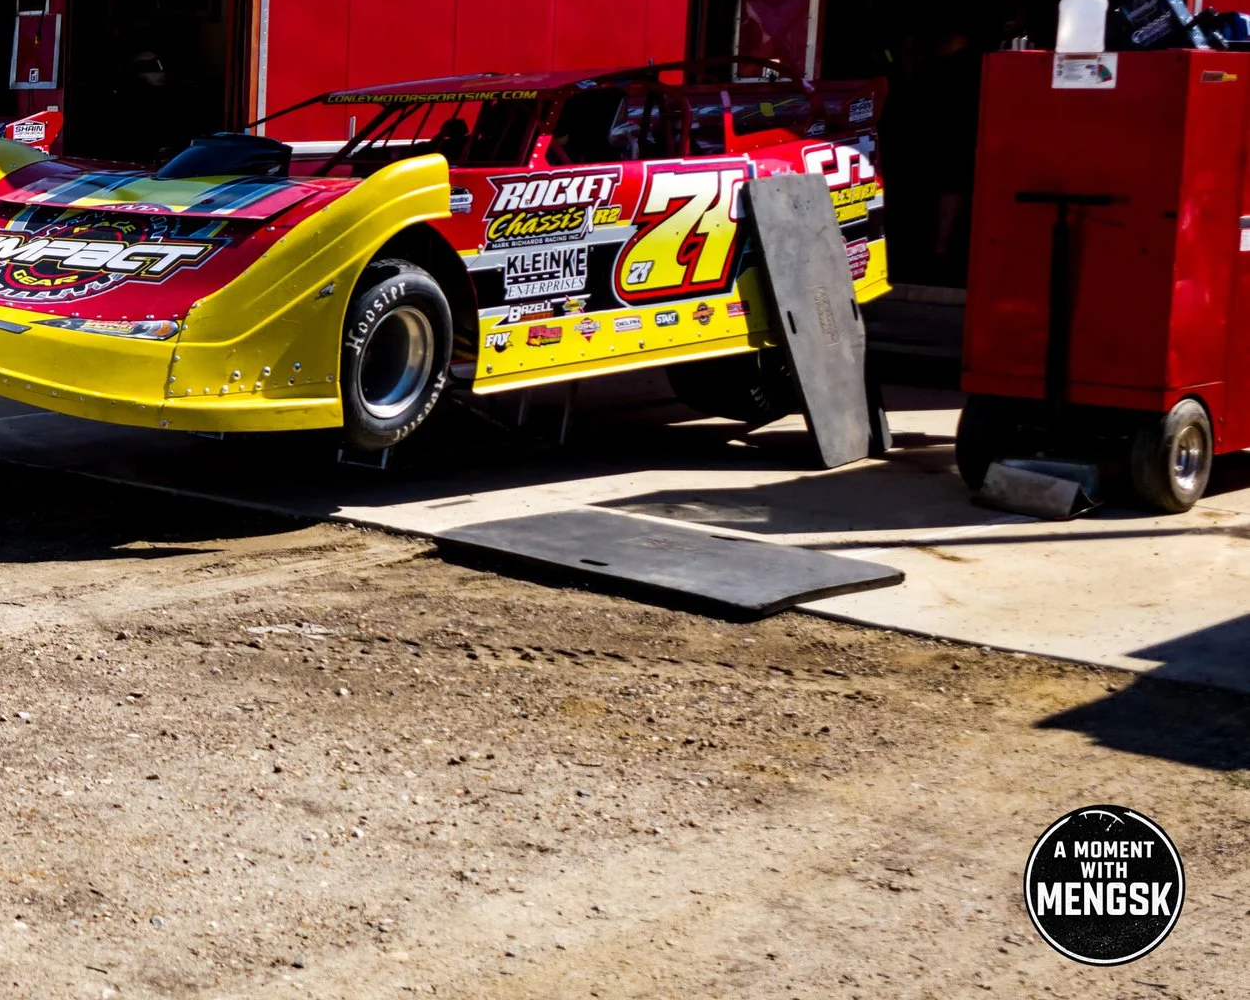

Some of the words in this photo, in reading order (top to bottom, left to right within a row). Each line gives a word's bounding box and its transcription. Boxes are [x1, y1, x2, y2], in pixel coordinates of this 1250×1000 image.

[15, 125, 43, 133] SHAIN
[493, 173, 619, 212] ROCKET
[488, 206, 586, 240] Chassis
[491, 241, 510, 250] MARK
[511, 238, 544, 247] RICHARDS
[544, 235, 568, 244] RACING
[506, 247, 587, 279] KLEINKE
[12, 268, 80, 287] GEAR
[507, 277, 585, 298] ENTERPRISES
[345, 281, 407, 356] Hoosier
[507, 302, 554, 324] BAZELL
[485, 331, 512, 347] FOX
